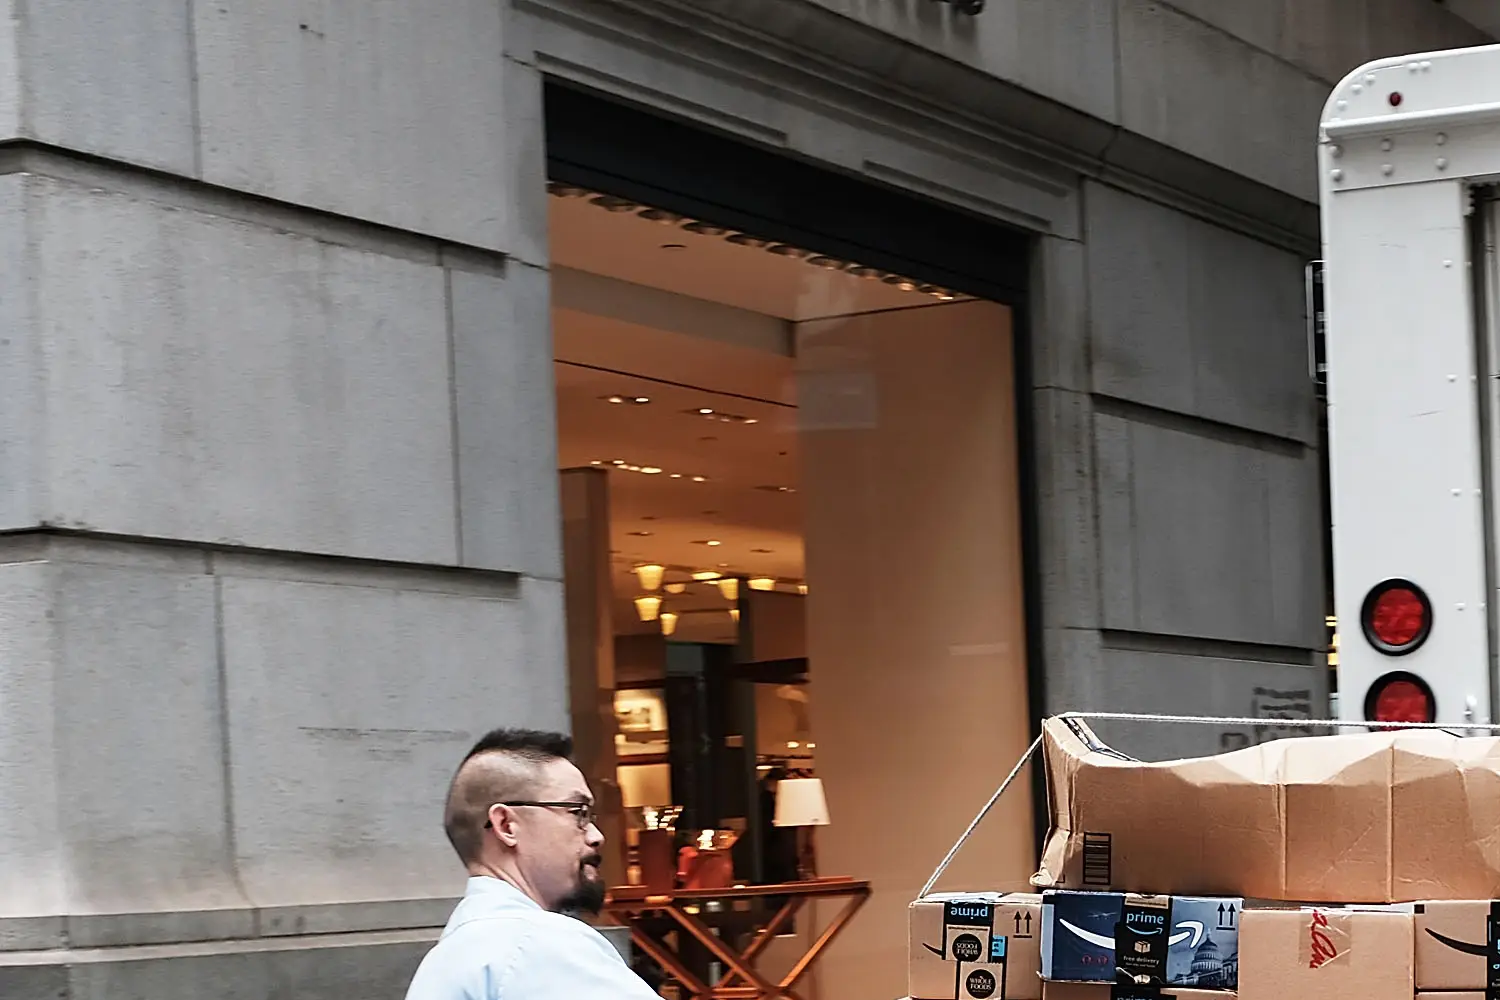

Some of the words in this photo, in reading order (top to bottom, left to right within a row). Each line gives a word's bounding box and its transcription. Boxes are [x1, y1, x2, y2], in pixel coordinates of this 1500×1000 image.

[950, 906, 989, 920] prime
[1126, 911, 1165, 925] prime
[1136, 956, 1160, 965] delivery
